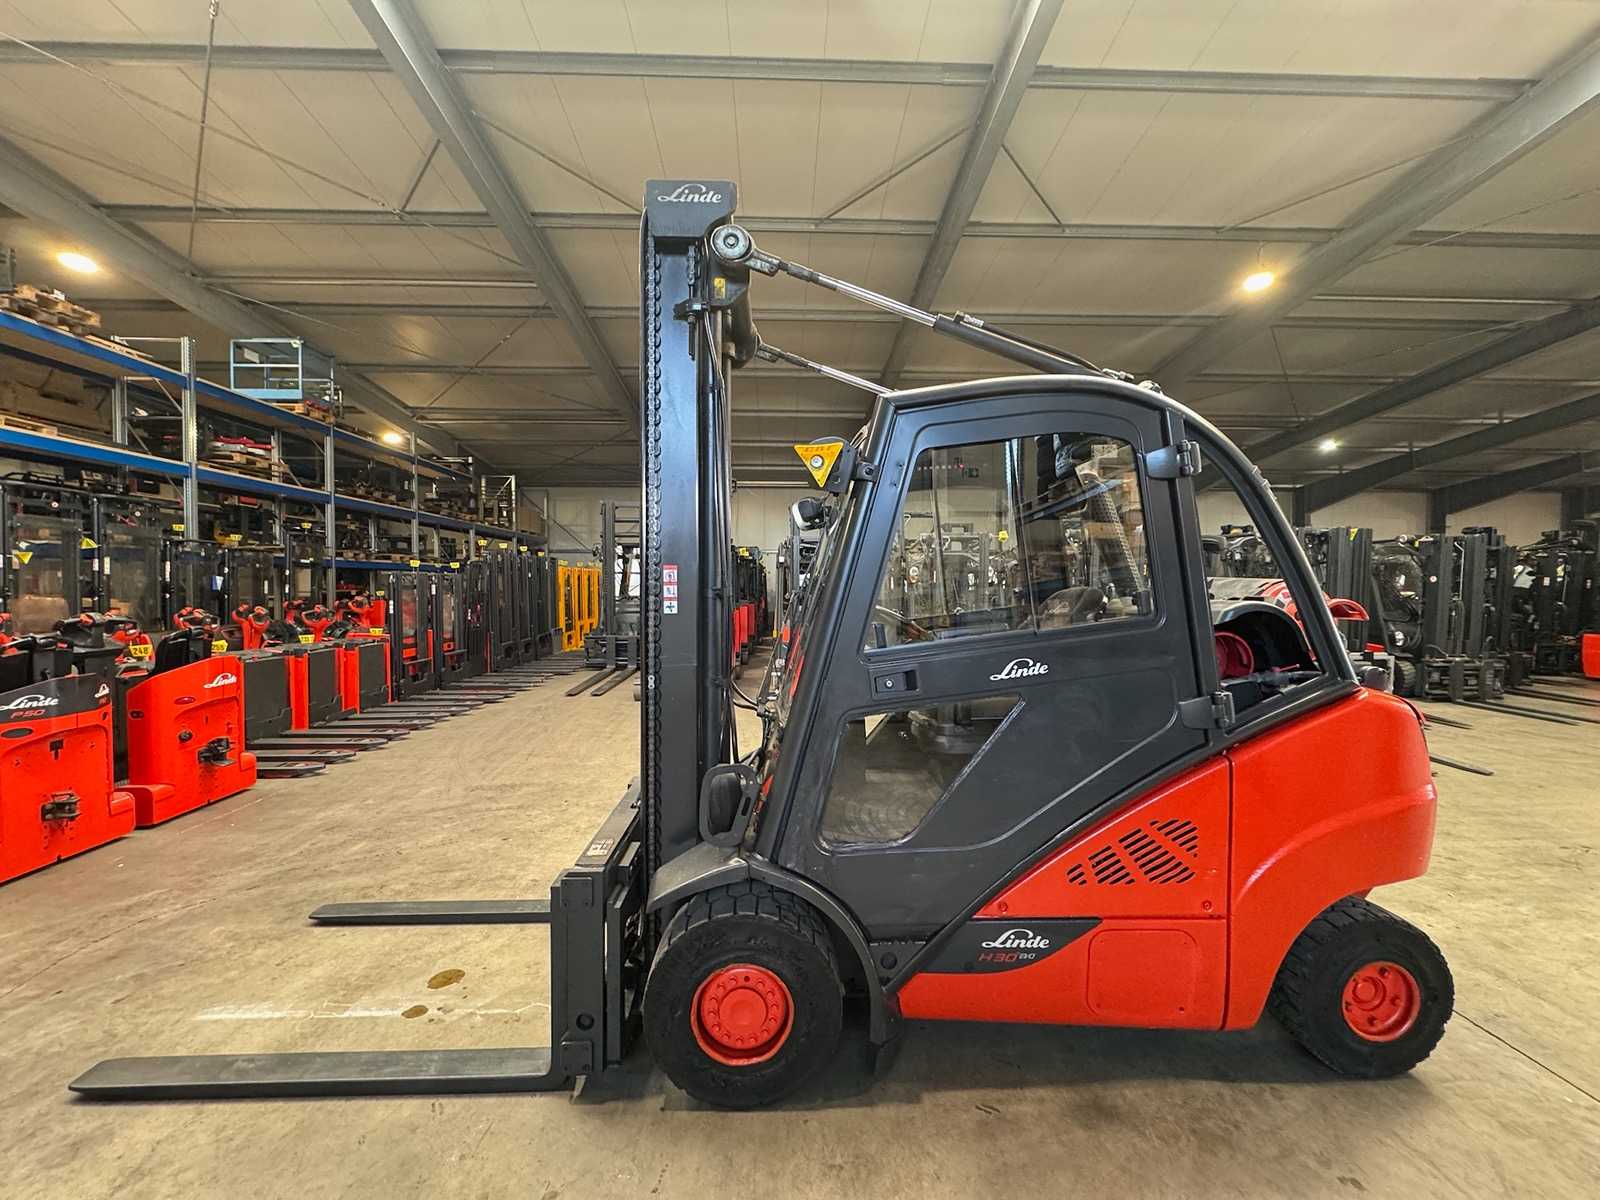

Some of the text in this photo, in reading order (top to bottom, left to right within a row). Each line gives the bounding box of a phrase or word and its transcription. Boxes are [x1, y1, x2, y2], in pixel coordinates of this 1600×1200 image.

[656, 183, 722, 204] Linde
[989, 657, 1049, 681] Linde
[0, 694, 59, 711] Linde
[981, 928, 1050, 949] Linde
